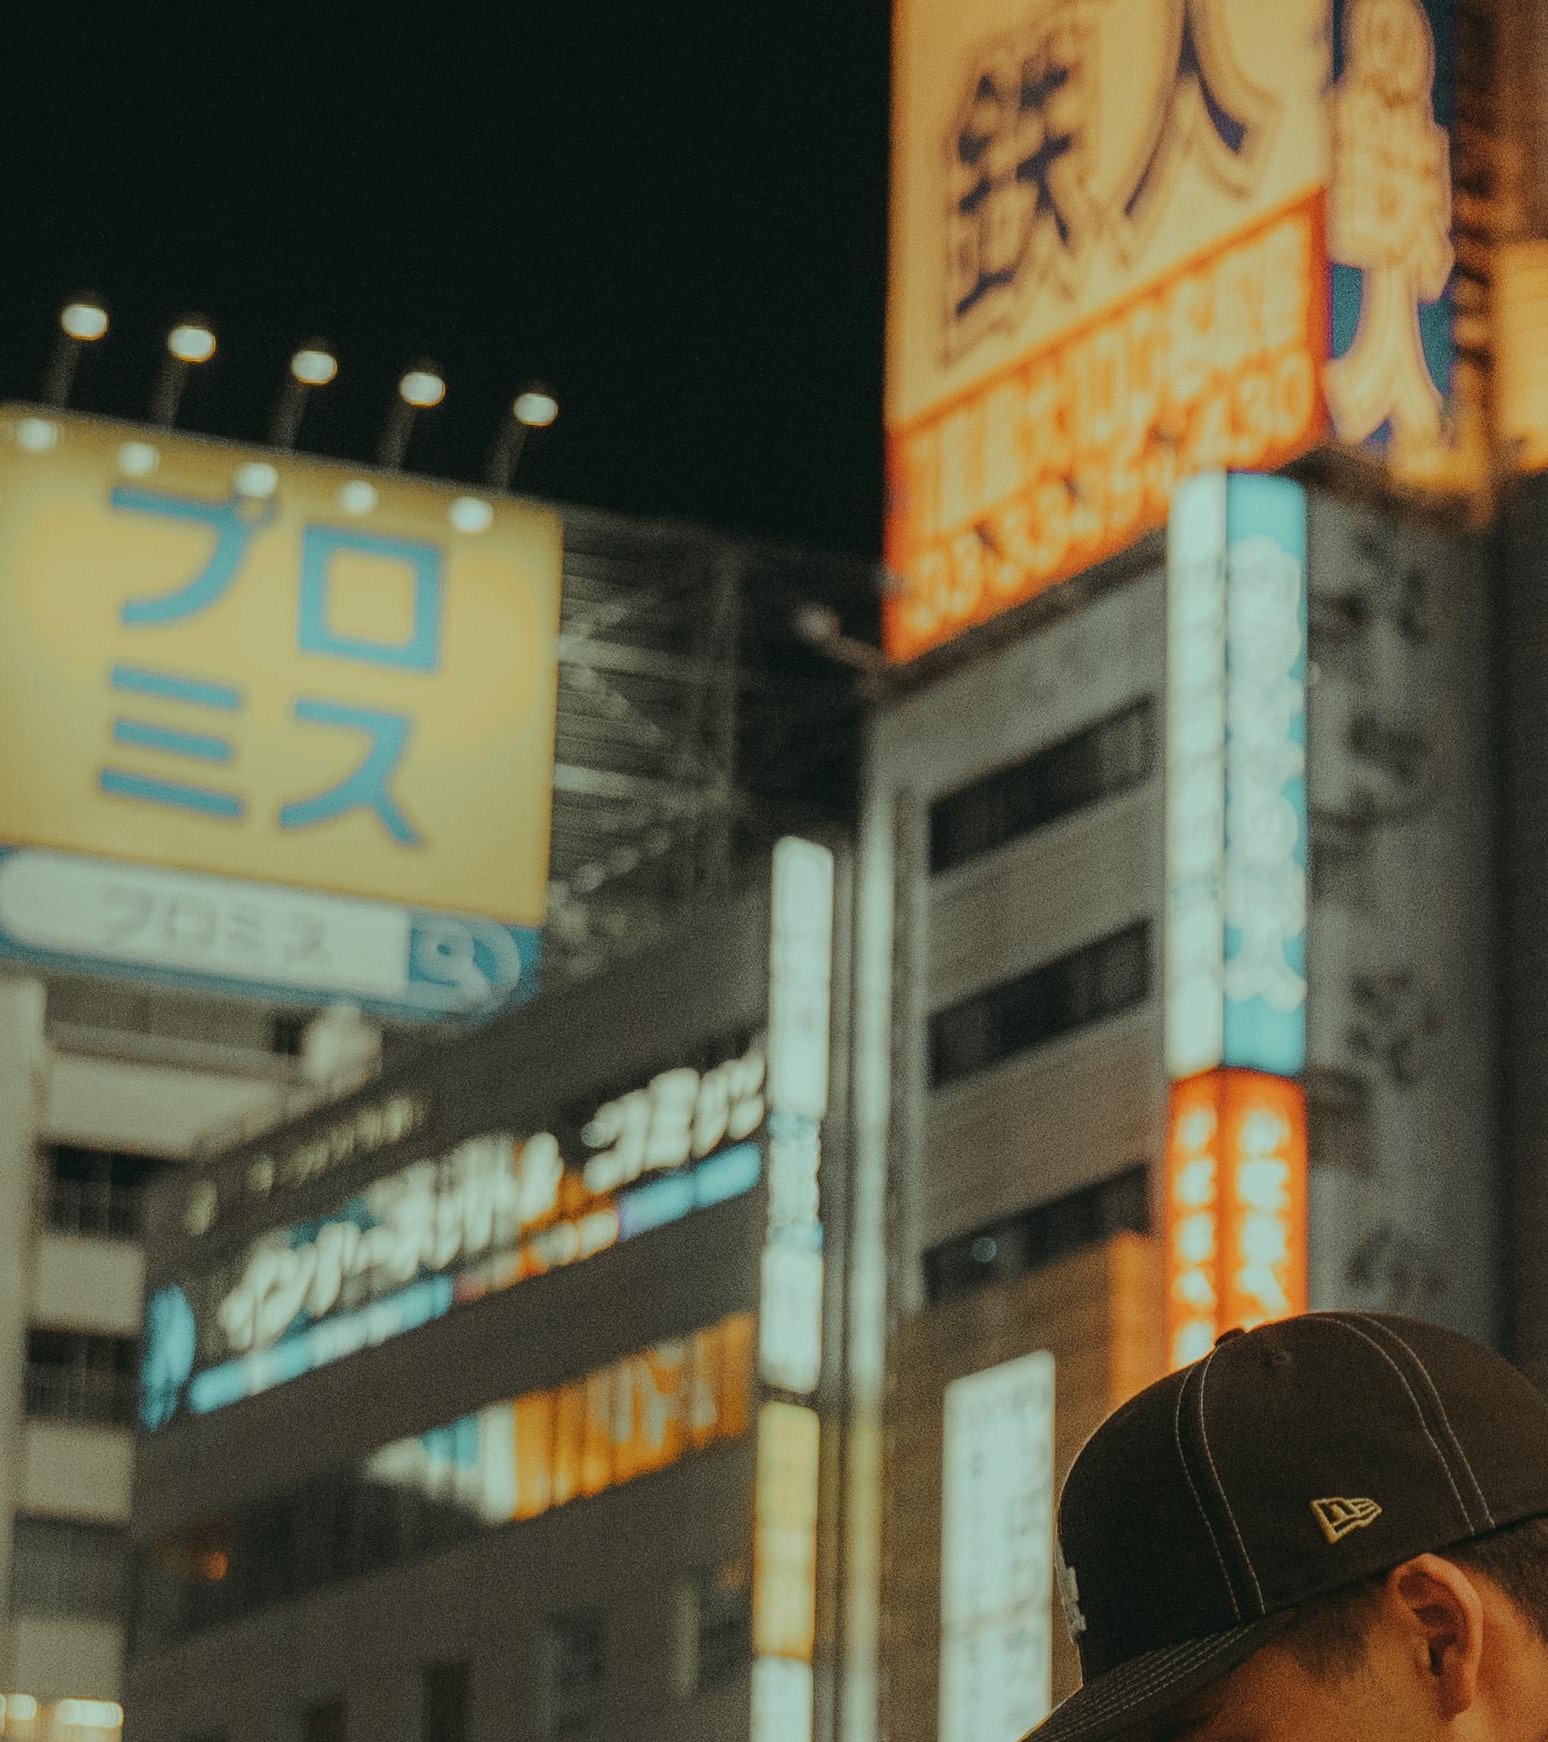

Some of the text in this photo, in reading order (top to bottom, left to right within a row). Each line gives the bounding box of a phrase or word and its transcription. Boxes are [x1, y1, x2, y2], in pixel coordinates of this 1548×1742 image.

[108, 484, 443, 675] プロ
[98, 664, 428, 847] ミス
[101, 882, 336, 970] プロミス
